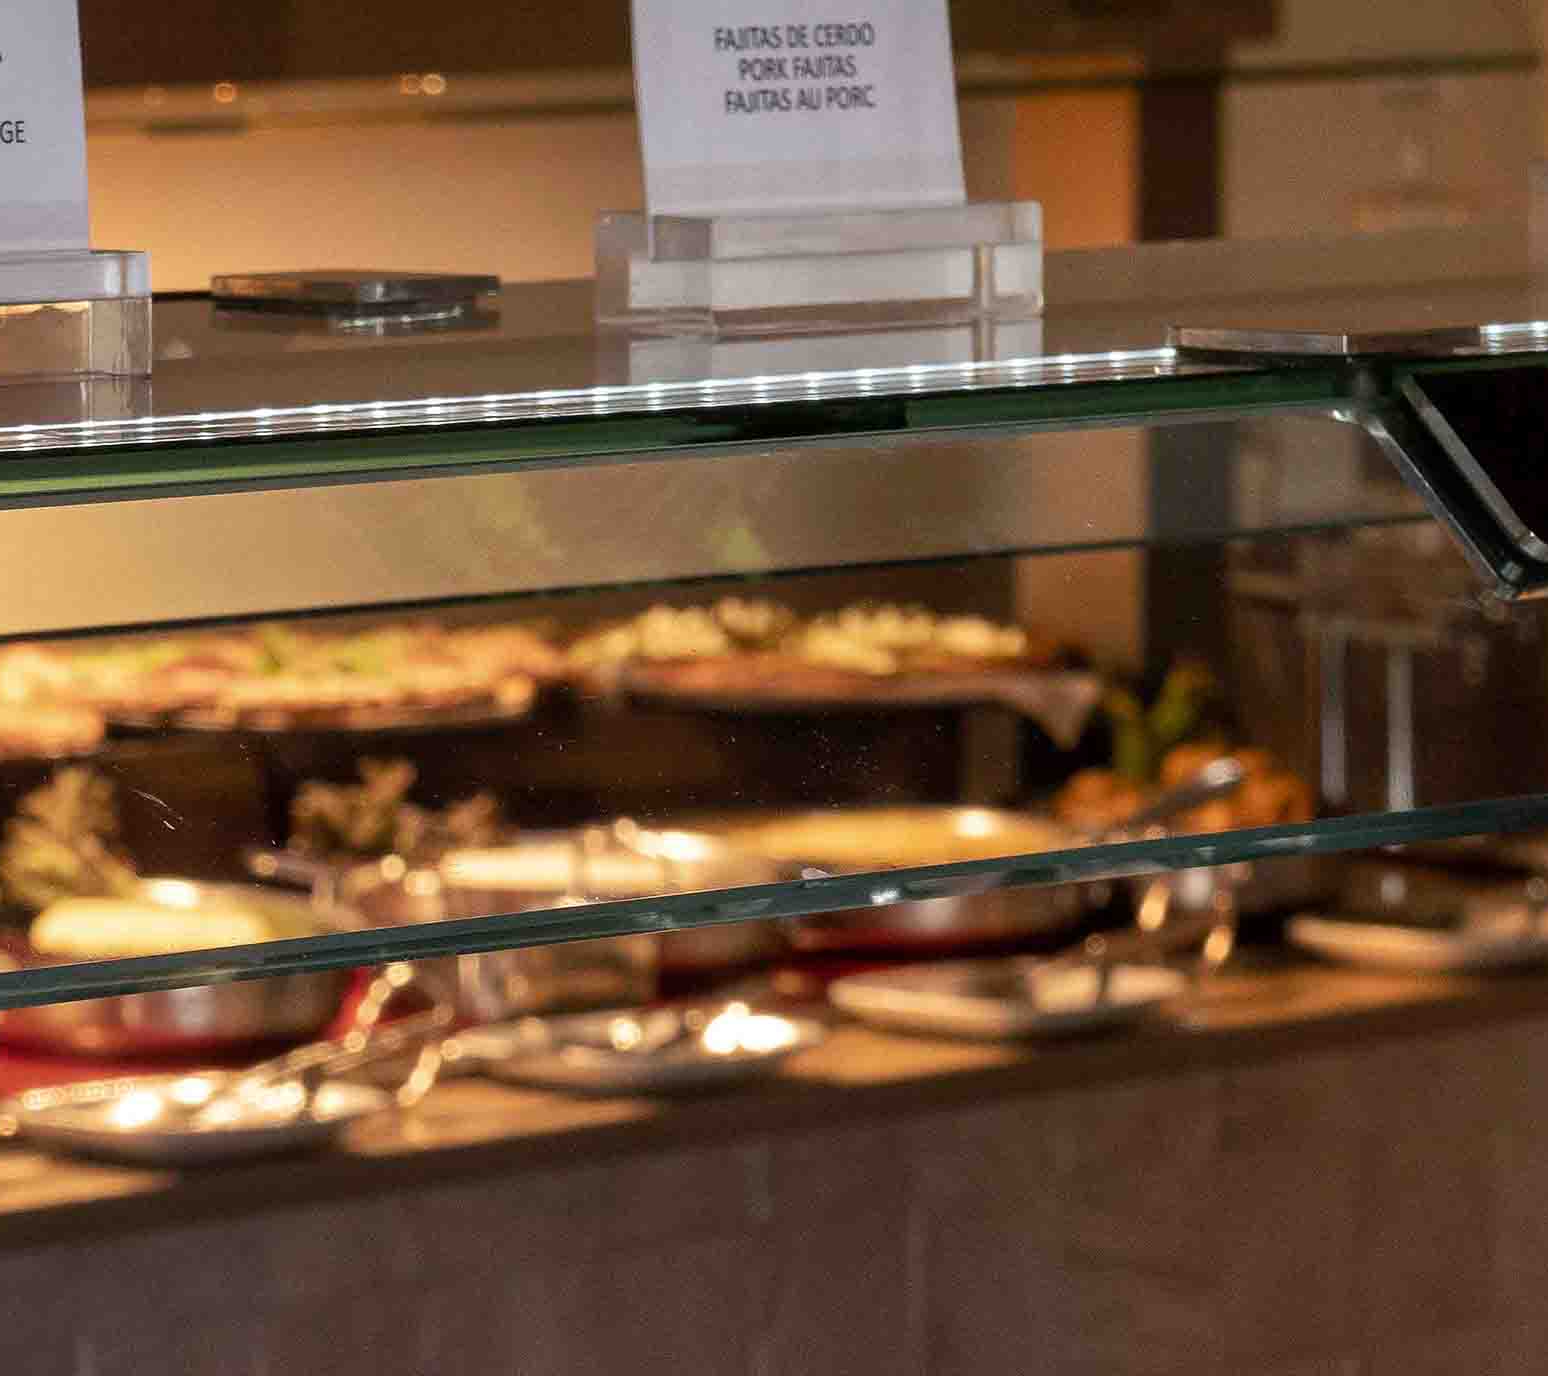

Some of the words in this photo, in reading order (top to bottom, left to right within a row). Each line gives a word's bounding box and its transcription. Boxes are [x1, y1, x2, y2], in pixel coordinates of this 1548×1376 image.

[713, 24, 784, 52] FAJITAS
[786, 24, 810, 50] DE
[813, 21, 876, 49] CERDO
[737, 57, 789, 82] PORK
[792, 54, 858, 81] FAJITAS
[724, 88, 793, 115] FAJITAS
[796, 87, 822, 112] AU
[825, 84, 877, 111] PORC
